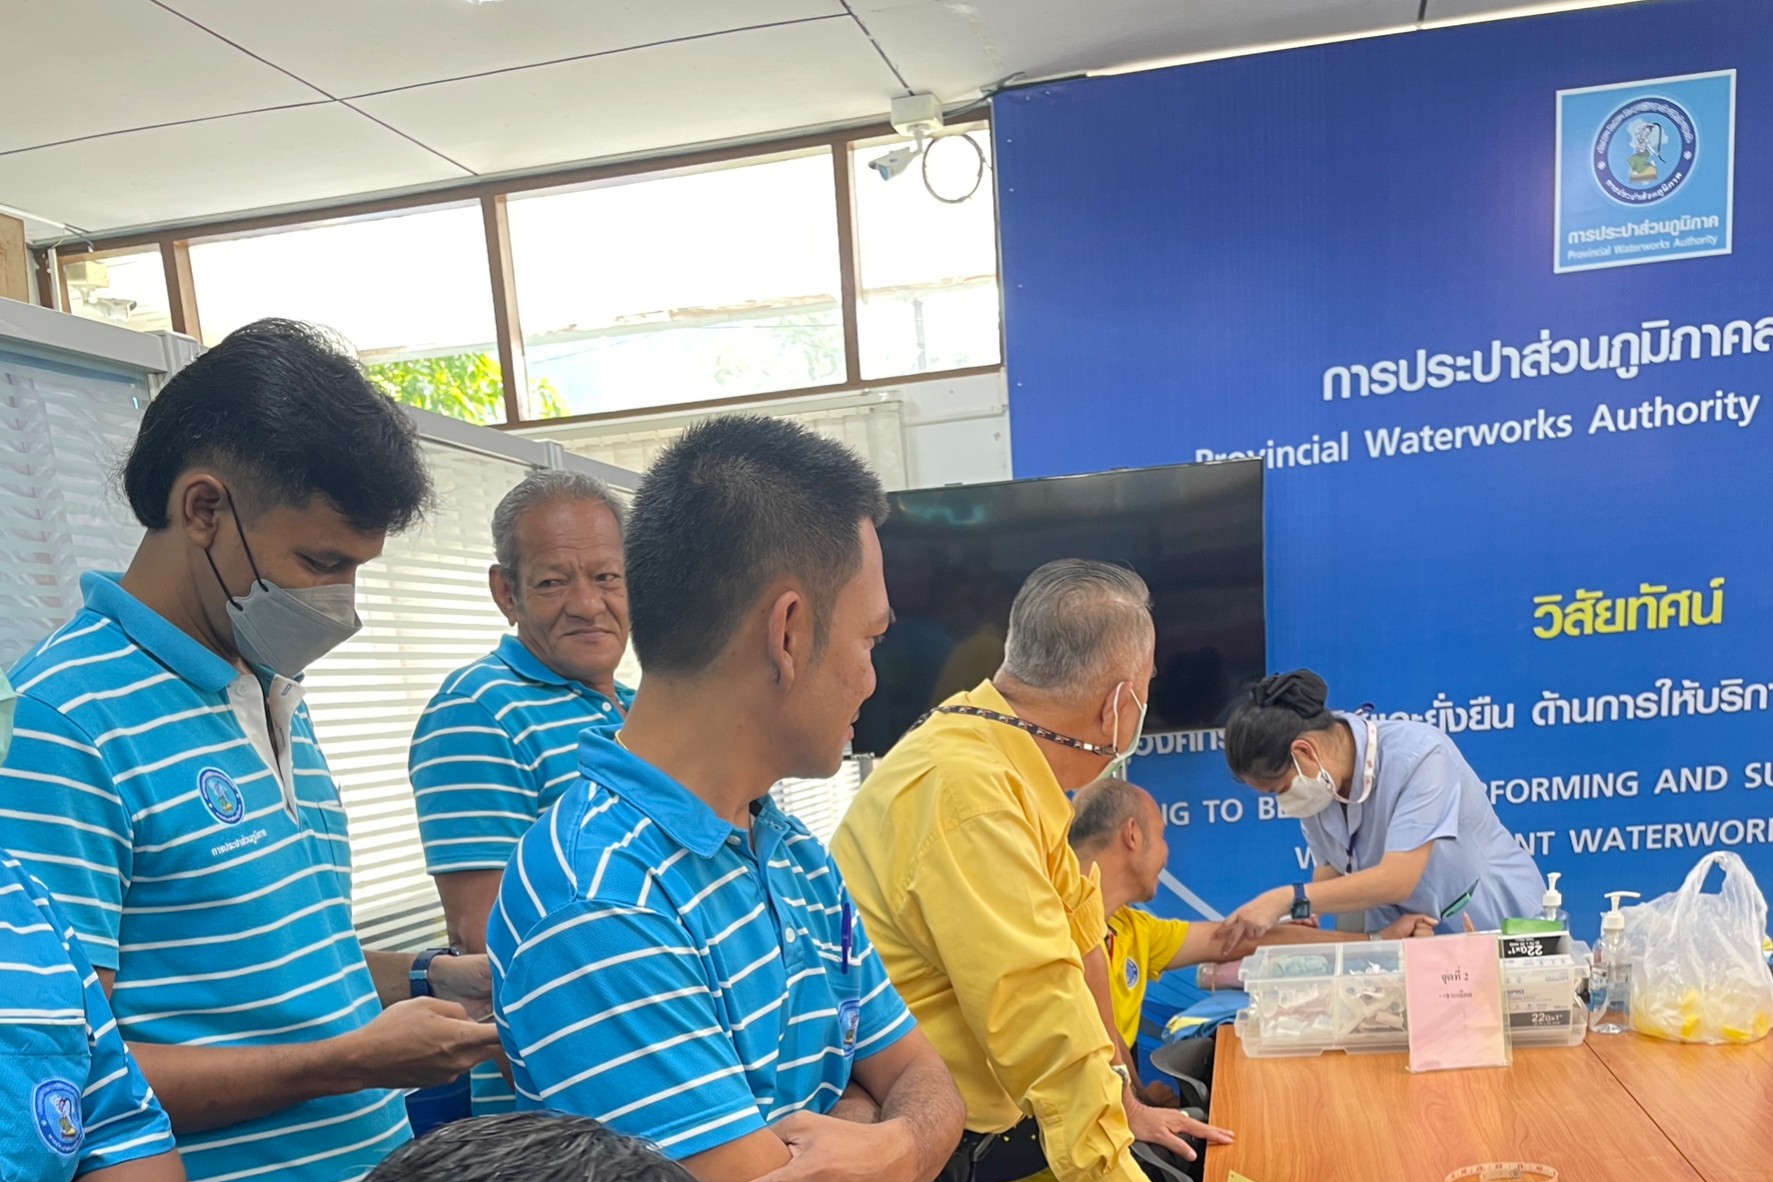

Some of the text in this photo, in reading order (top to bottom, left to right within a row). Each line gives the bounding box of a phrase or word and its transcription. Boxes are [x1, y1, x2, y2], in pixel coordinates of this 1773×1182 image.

[1567, 234, 1718, 260] Provincial Waterworks Authority
[1568, 215, 1720, 244] การประปาส่วนภูมิภาค
[1364, 409, 1573, 458] Waterworks
[1588, 390, 1760, 434] Authority
[1533, 577, 1725, 639] วิสัยทัศน์
[1532, 679, 1773, 726] ด้านการให้บริก
[1203, 799, 1243, 823] TO
[1654, 766, 1728, 795] AND
[1464, 972, 1469, 981] 2
